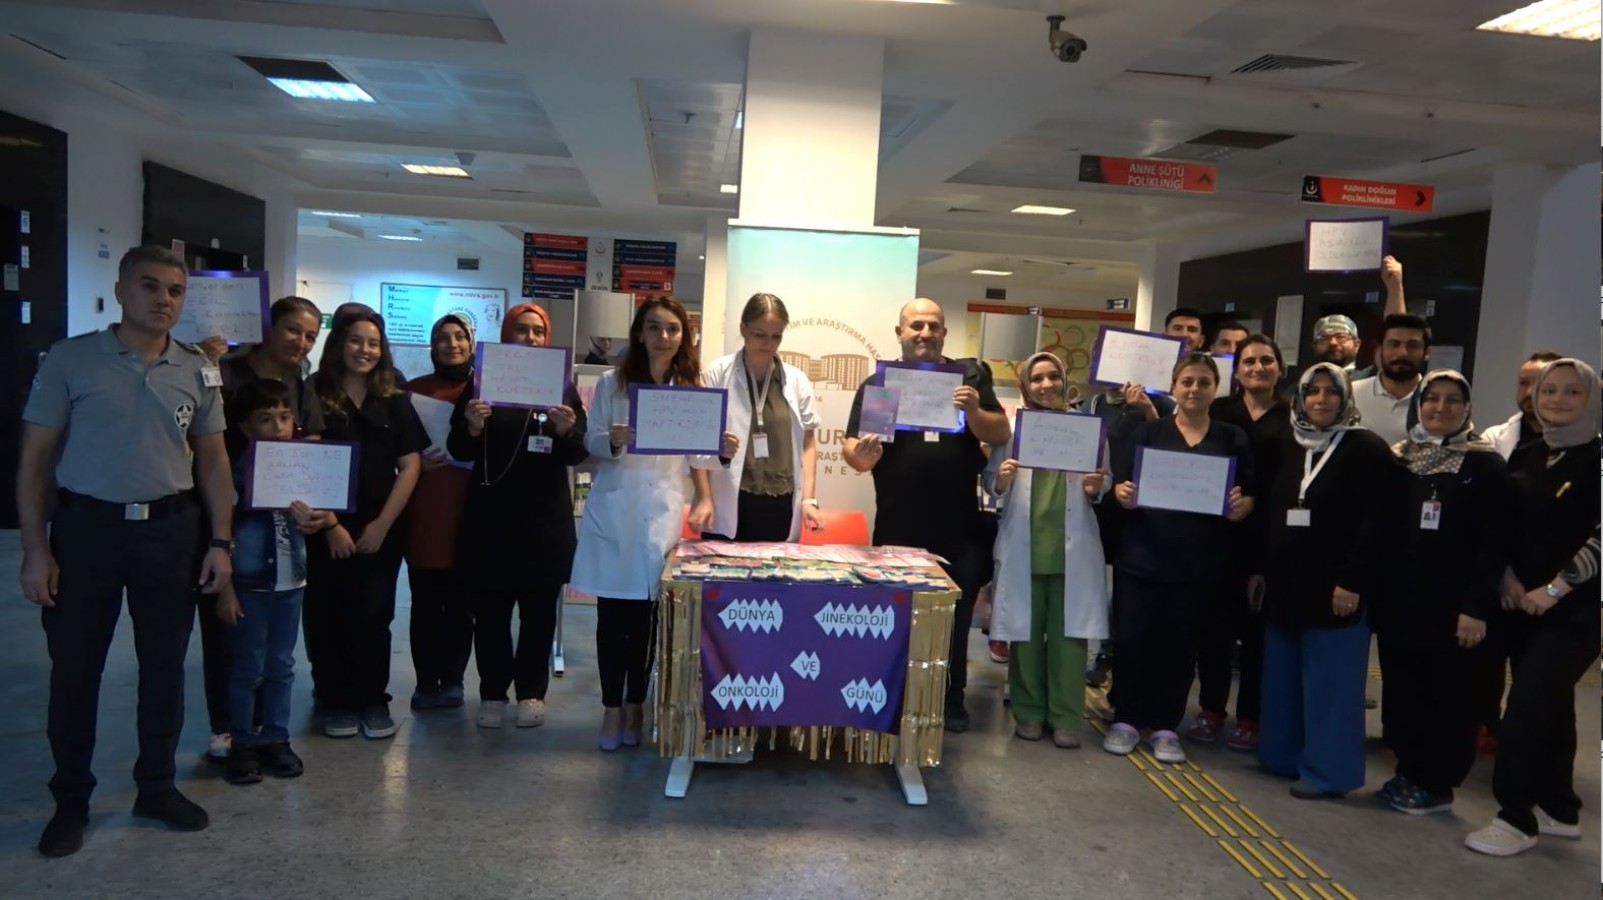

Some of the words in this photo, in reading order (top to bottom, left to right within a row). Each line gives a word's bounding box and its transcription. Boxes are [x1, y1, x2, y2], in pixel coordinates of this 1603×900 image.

[1129, 163, 1157, 175] ANNE
[1159, 164, 1185, 177] SÜTÜ
[802, 317, 815, 326] VE
[816, 318, 867, 345] ARAŞTIRMA
[865, 342, 882, 360] HAS
[727, 605, 776, 622] DÜNYA
[820, 610, 889, 627] JİNEKOLOJİ
[801, 660, 817, 672] VE
[718, 684, 779, 699] ONKOLOJİ
[846, 686, 884, 702] GÜNÜ
